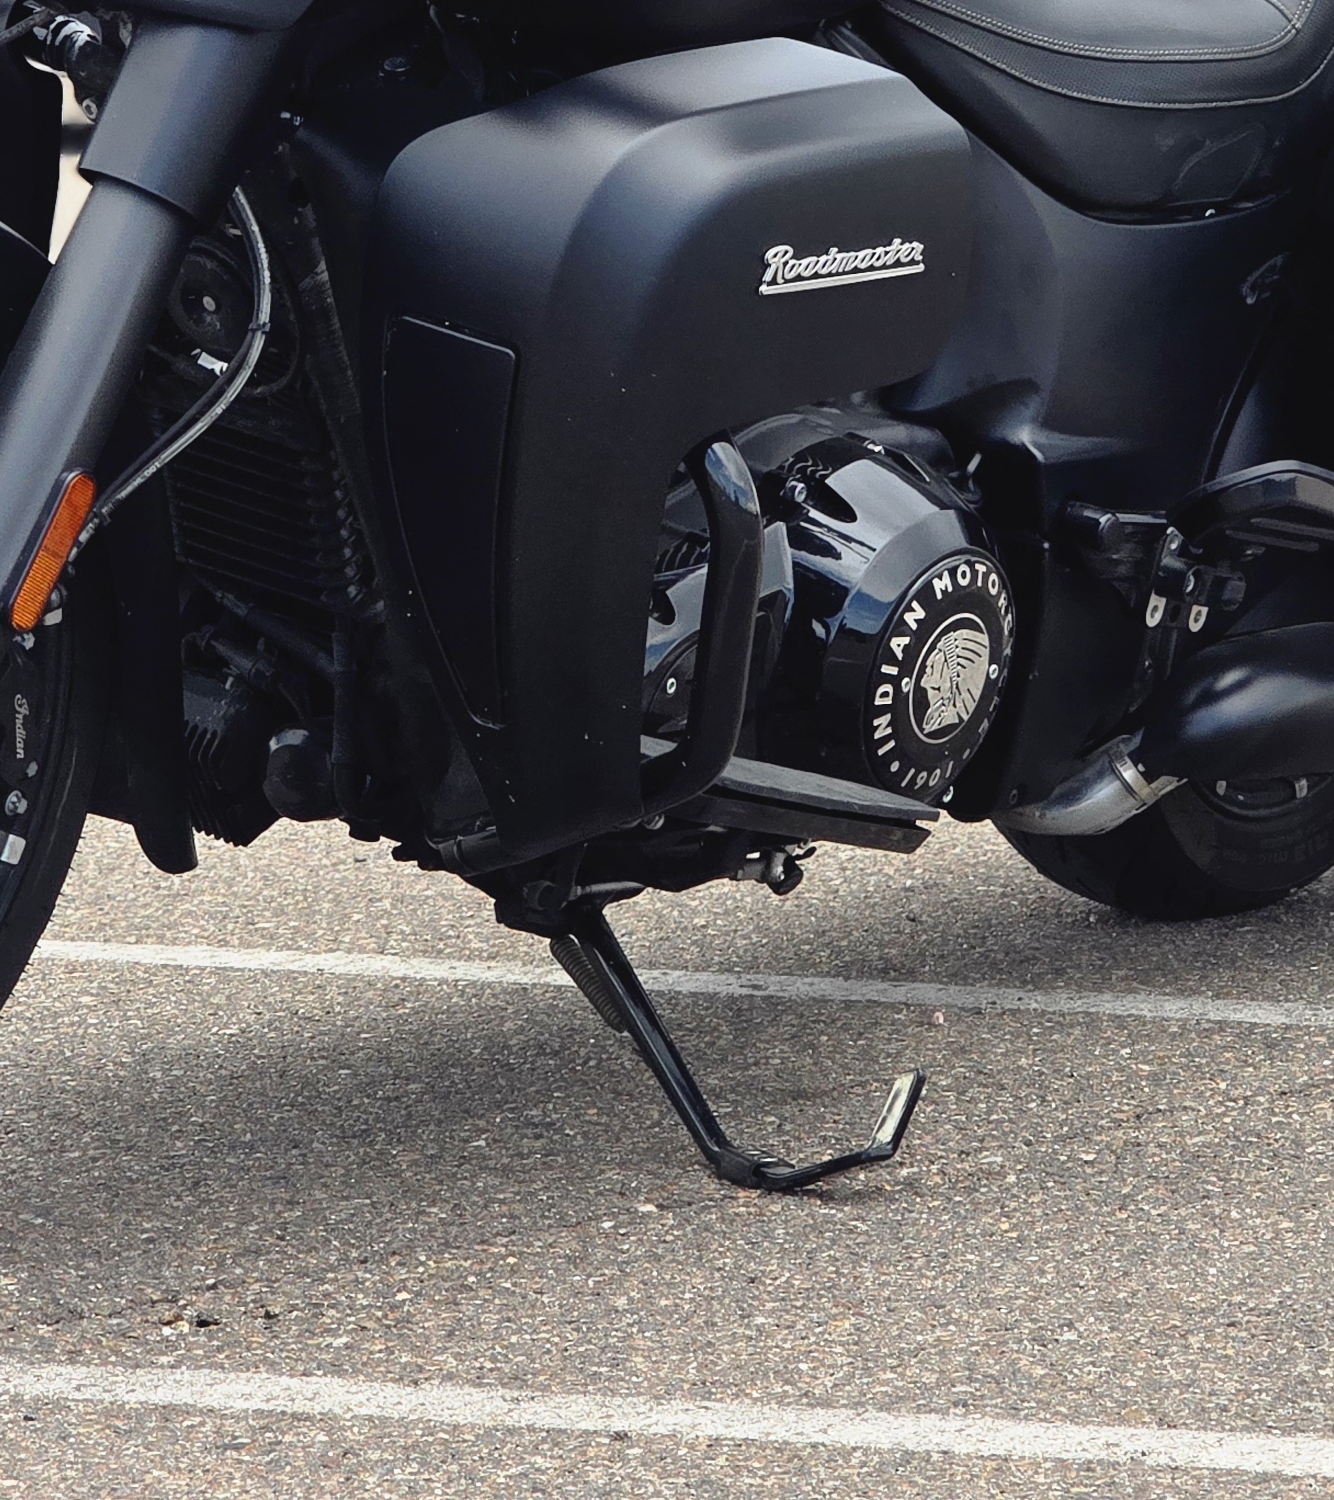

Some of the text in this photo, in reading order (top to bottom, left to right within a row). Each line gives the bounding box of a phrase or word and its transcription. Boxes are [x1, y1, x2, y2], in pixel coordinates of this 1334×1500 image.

[762, 238, 924, 286] Roadmaster
[872, 600, 926, 756] INDIAN
[14, 694, 29, 759] Indian
[901, 760, 955, 790] 1901
